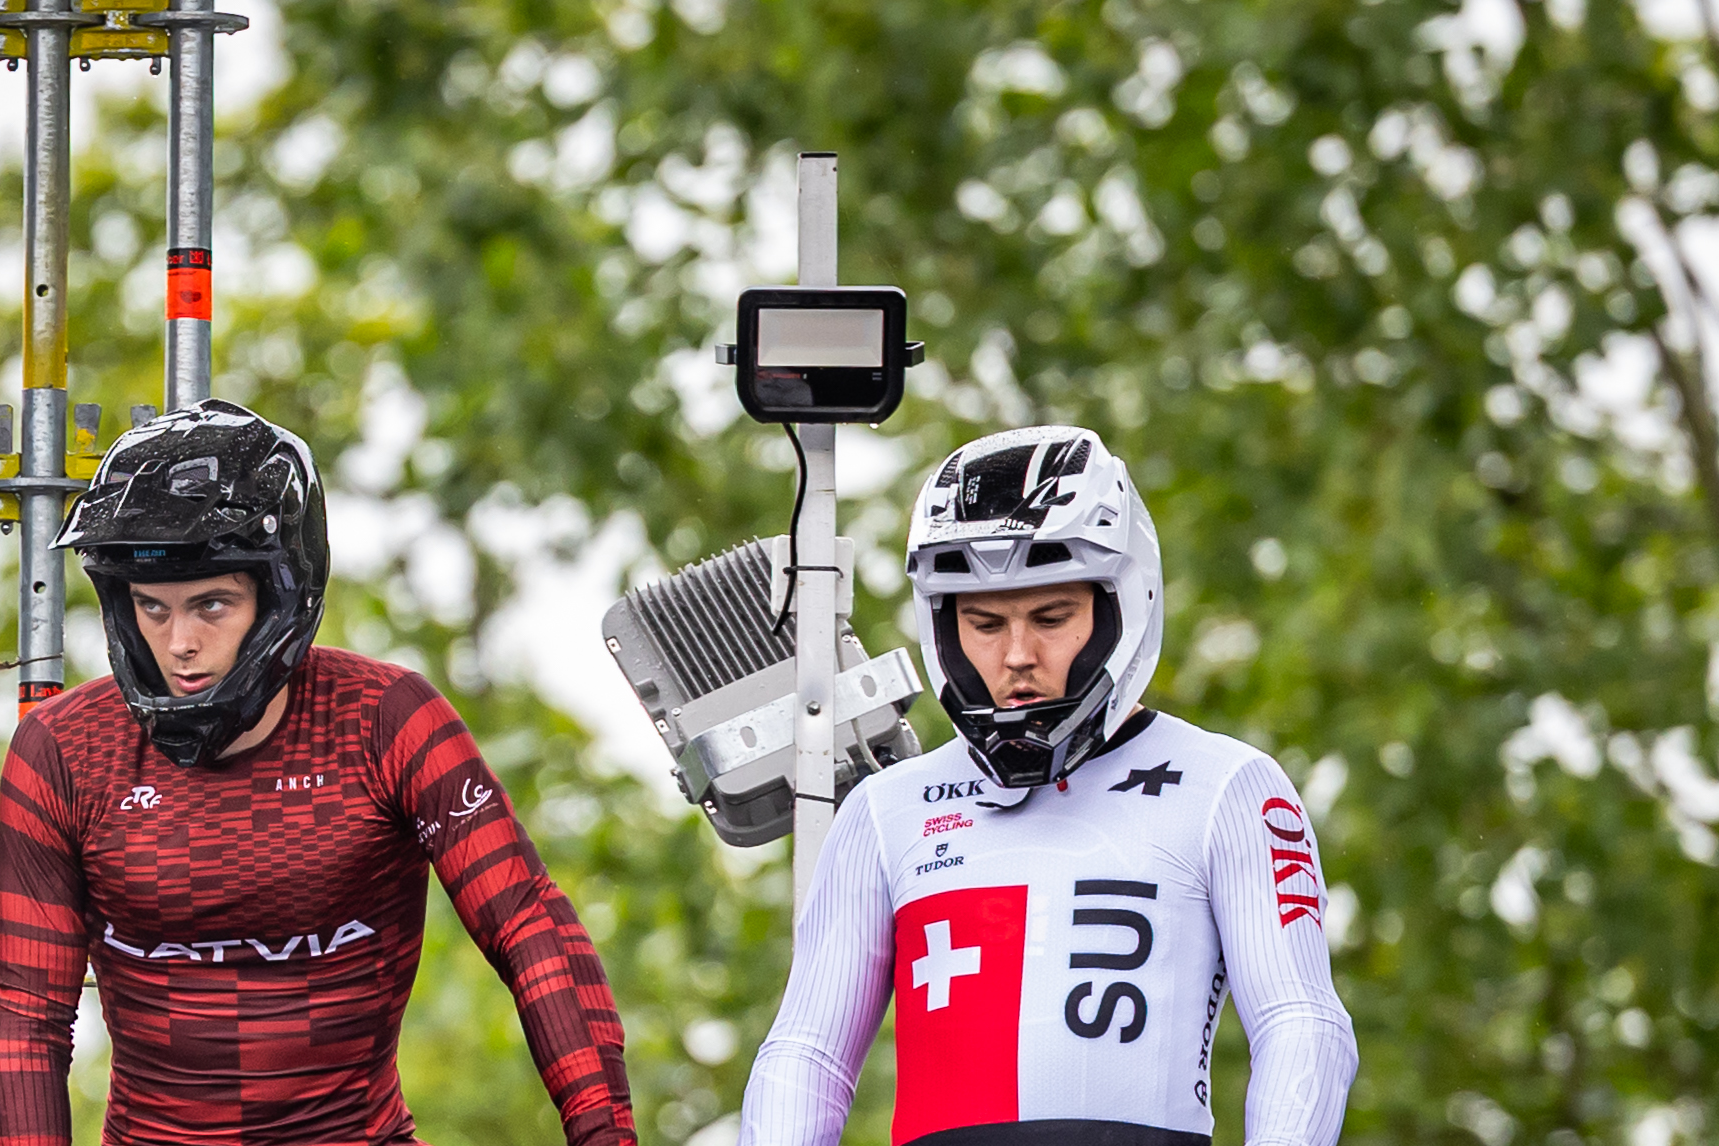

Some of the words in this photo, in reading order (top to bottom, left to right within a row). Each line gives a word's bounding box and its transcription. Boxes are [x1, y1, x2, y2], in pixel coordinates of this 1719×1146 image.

[275, 774, 324, 792] ANCH
[923, 819, 973, 837] CYCLING
[924, 812, 962, 828] SWISS
[915, 856, 964, 876] TUDOR
[103, 919, 376, 962] LATVIA
[1064, 879, 1158, 1044] SUI
